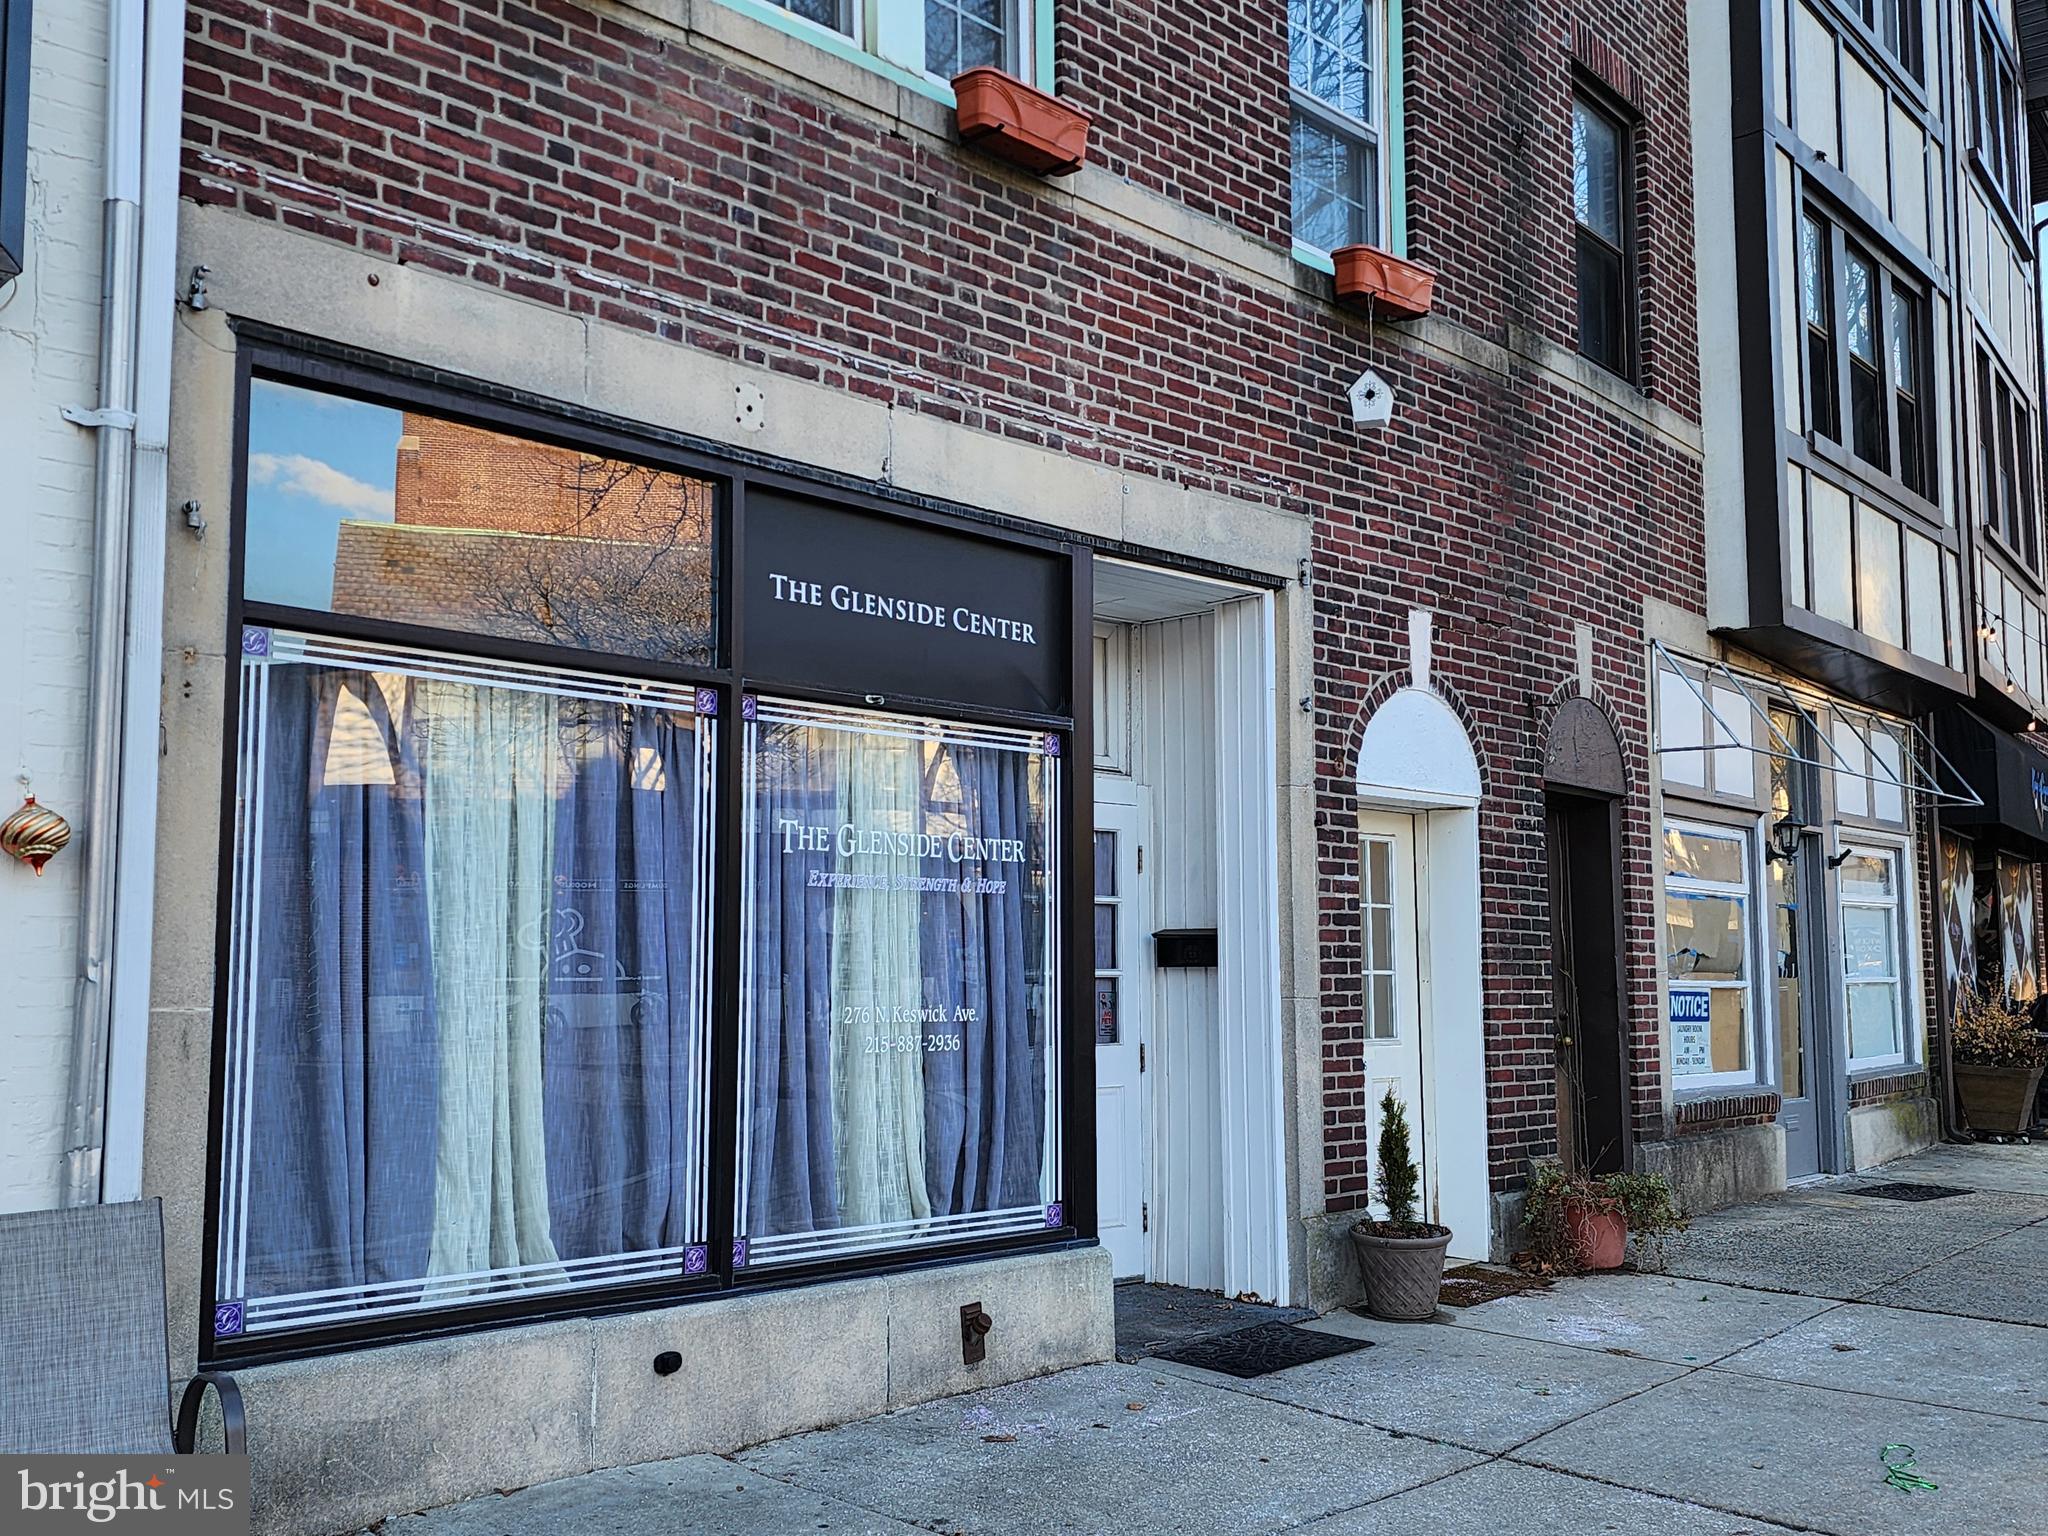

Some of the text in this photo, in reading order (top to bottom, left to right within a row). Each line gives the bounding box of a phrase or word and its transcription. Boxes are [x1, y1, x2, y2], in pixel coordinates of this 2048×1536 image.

[769, 573, 1036, 644] THE GLENSIDE CENTER
[779, 818, 1026, 863] THE GLENSIDE CENTER
[893, 874, 958, 892] STRENGTH
[960, 877, 972, 893] &
[975, 878, 1006, 894] HOPE
[843, 1005, 979, 1024] 276 N. Keswick Ave.
[1670, 995, 1709, 1017] NOTICE
[865, 1034, 960, 1053] 215-887-2936
